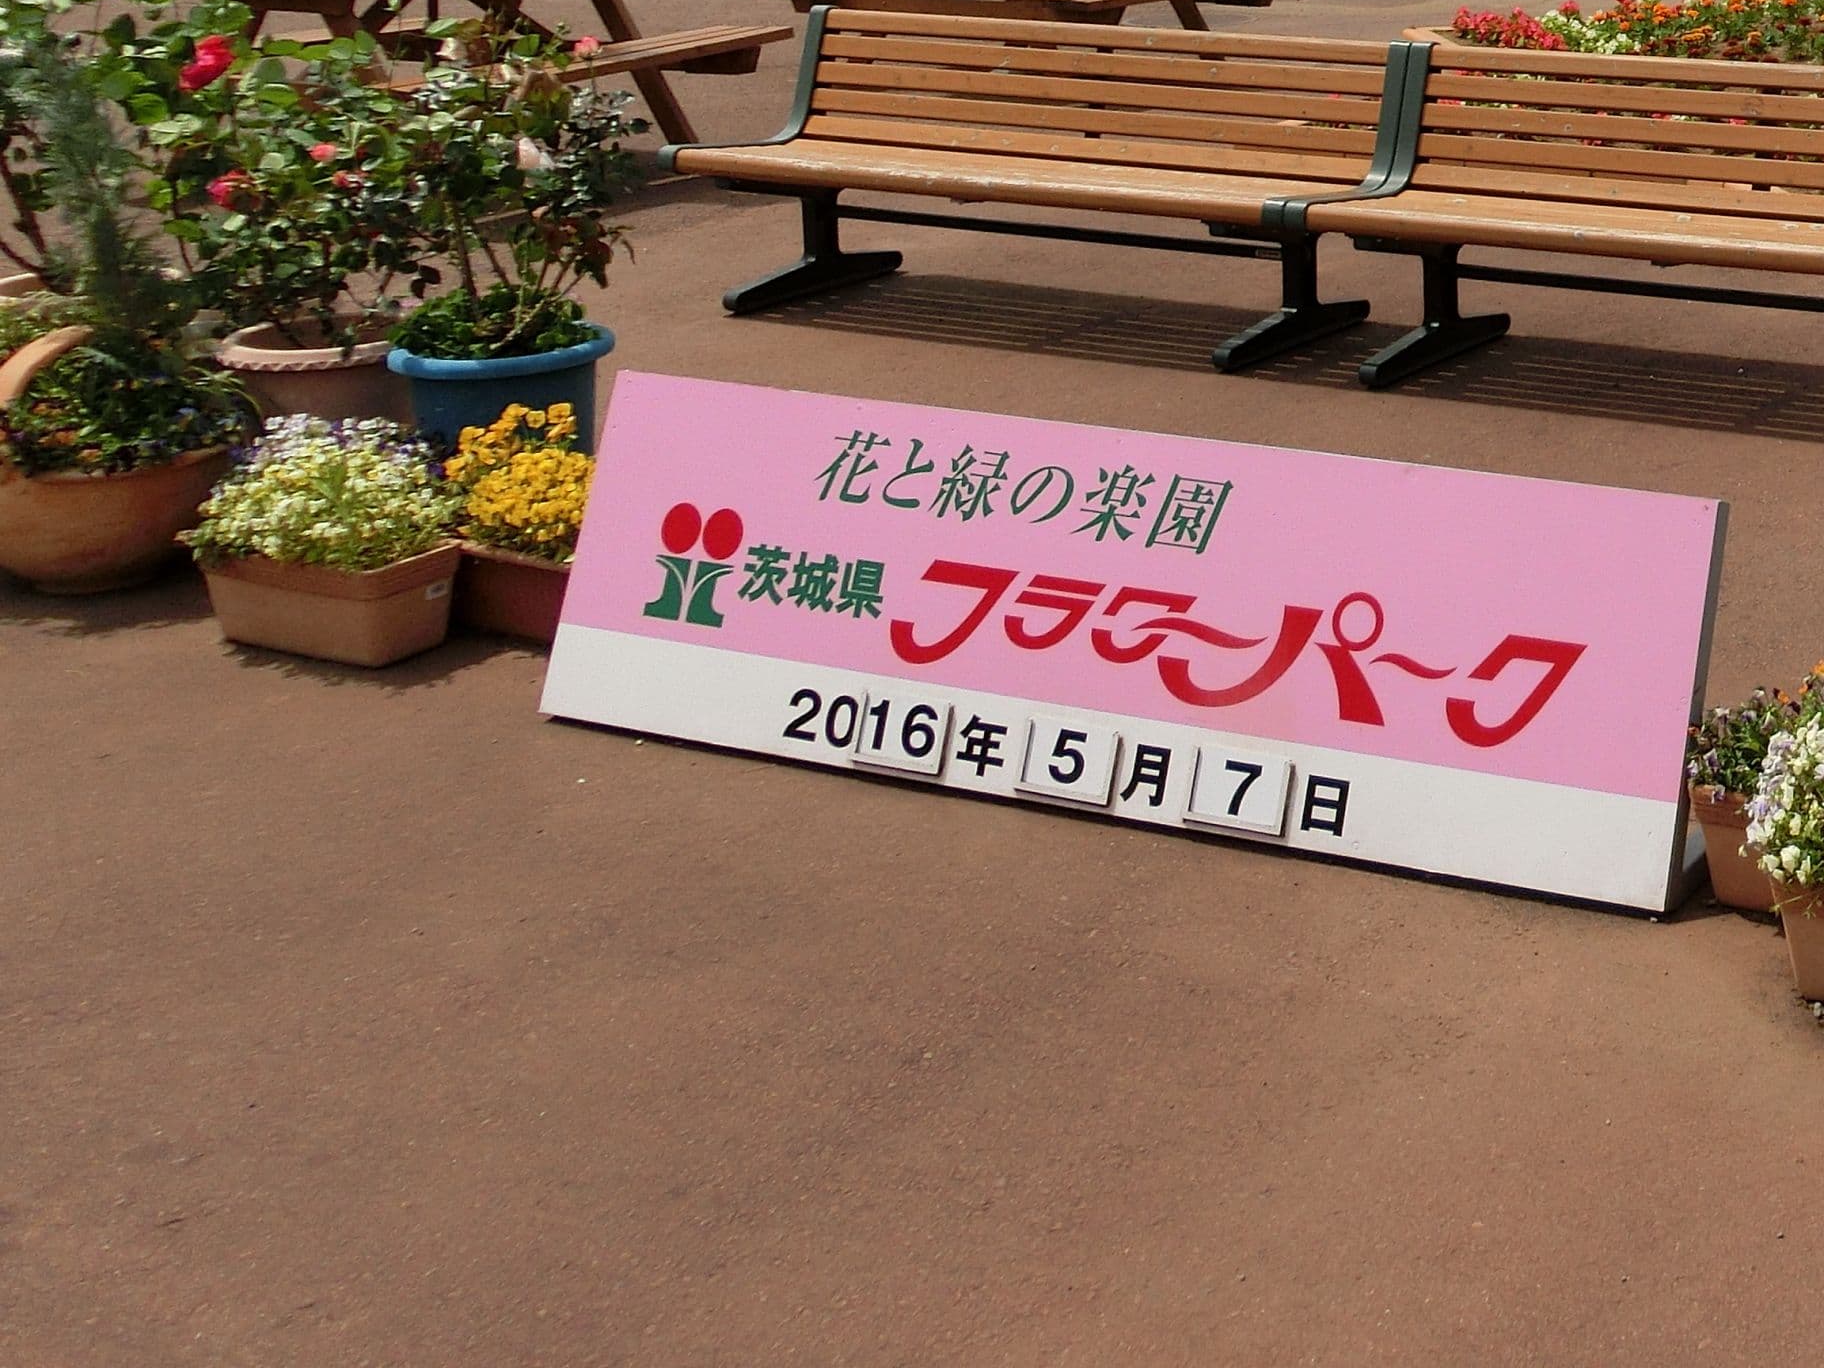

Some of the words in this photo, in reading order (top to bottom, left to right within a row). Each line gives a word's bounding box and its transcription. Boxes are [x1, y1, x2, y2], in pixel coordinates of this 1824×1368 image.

[814, 429, 1234, 555] 花と緑の楽園
[738, 543, 885, 619] 茨城県
[889, 559, 1588, 749] フラワーパーク
[782, 688, 1351, 837] 2016年5月7日
